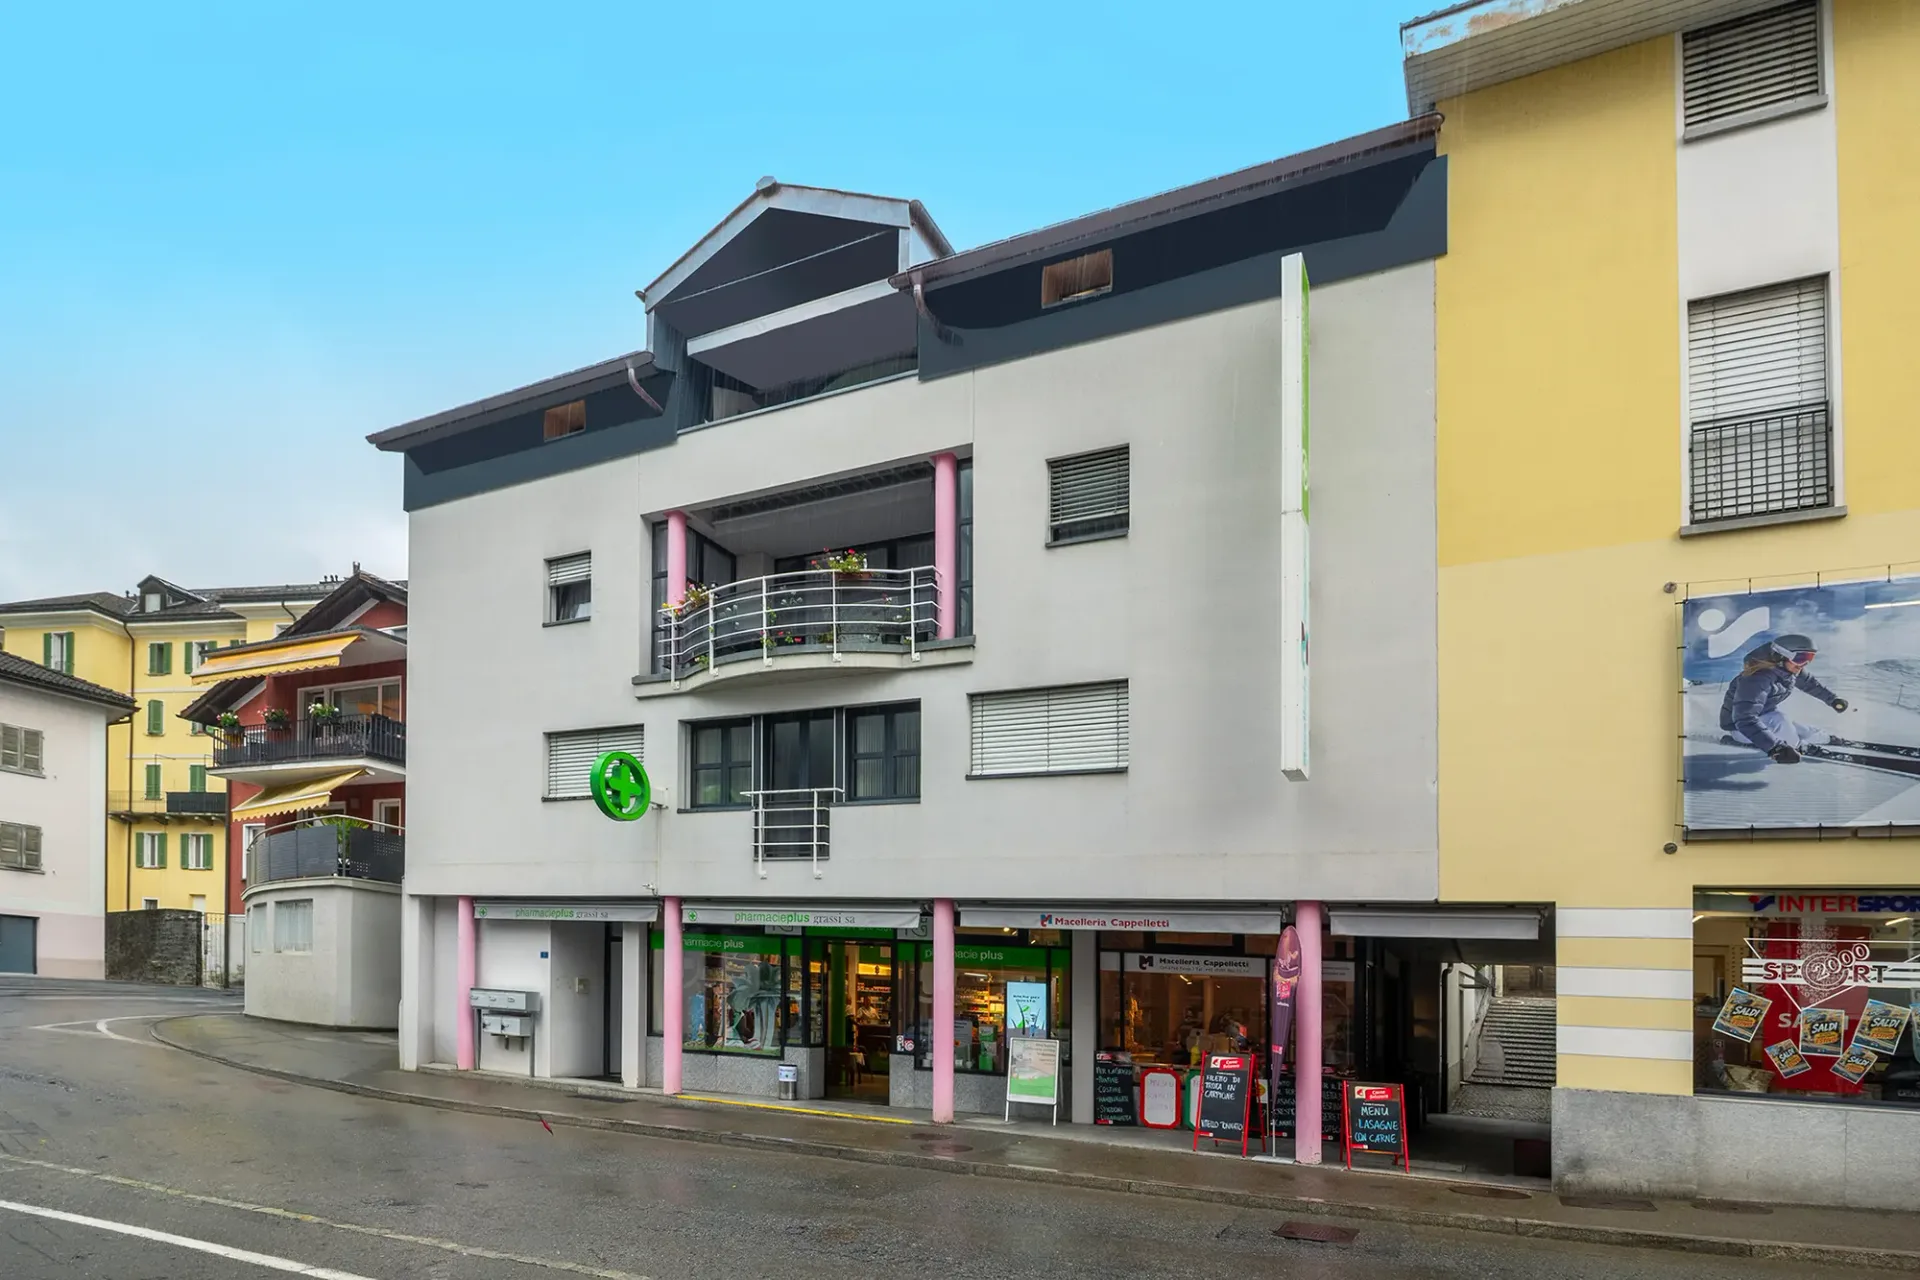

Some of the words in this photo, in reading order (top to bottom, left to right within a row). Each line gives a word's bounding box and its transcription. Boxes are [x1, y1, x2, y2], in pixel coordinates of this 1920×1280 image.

[515, 908, 574, 919] pharmacieplus
[575, 908, 597, 919] grassi
[734, 911, 810, 924] pharmacieplus
[813, 912, 842, 925] grassi
[844, 916, 855, 924] sa
[1054, 916, 1106, 927] Macelleria
[1110, 918, 1170, 929] Cappelletti
[723, 939, 745, 949] plus
[980, 950, 1004, 961] plus
[1159, 957, 1200, 966] Macelleria
[1203, 959, 1250, 968] Cappelletti
[1809, 943, 1870, 982] 2000
[1732, 1005, 1761, 1017] SALDI
[1811, 1022, 1838, 1034] SALDI
[1871, 1017, 1901, 1028] SALDI
[1847, 1055, 1870, 1066] SALDI
[1360, 1106, 1389, 1117] MENU
[1358, 1118, 1399, 1131] LASAGNE
[1368, 1133, 1398, 1144] CARNE
